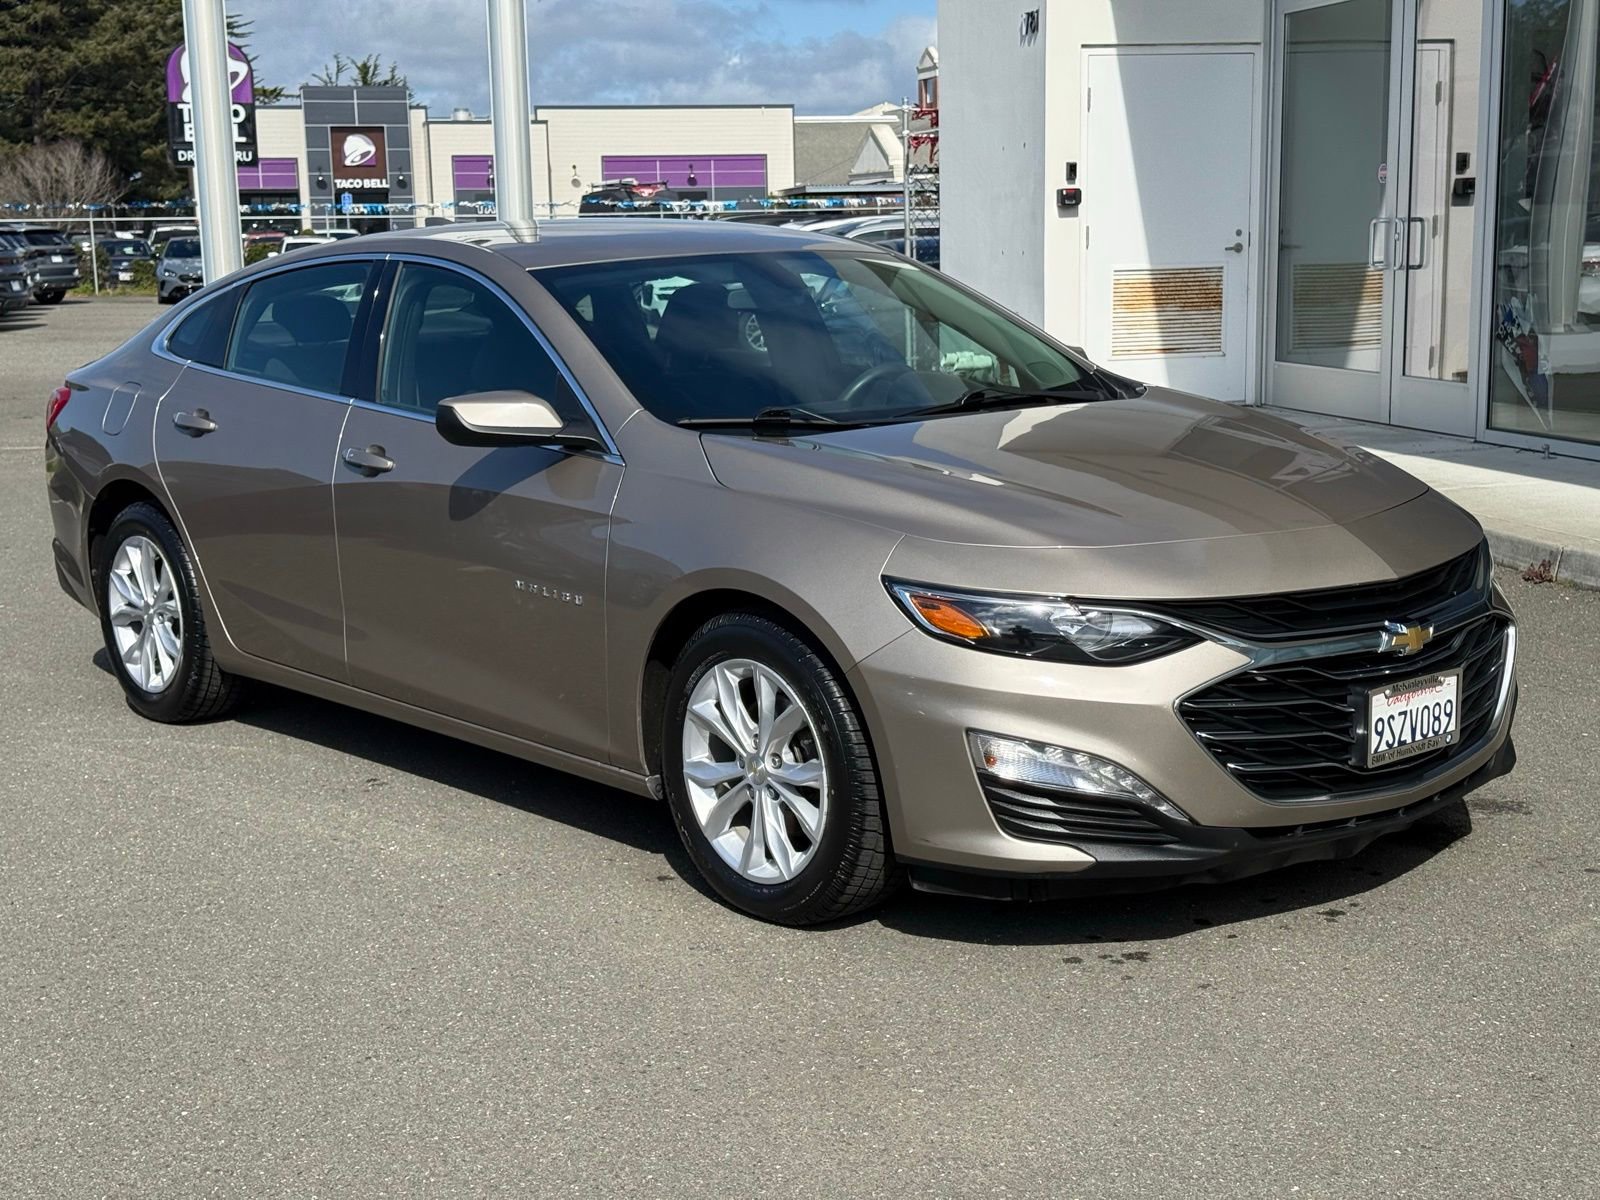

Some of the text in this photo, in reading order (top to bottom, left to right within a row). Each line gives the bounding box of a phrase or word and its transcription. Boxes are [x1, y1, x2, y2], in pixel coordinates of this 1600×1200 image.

[176, 103, 246, 124] TO
[183, 123, 247, 143] BL
[334, 178, 390, 189] TACO BELL
[1373, 699, 1454, 754] 9SZV089
